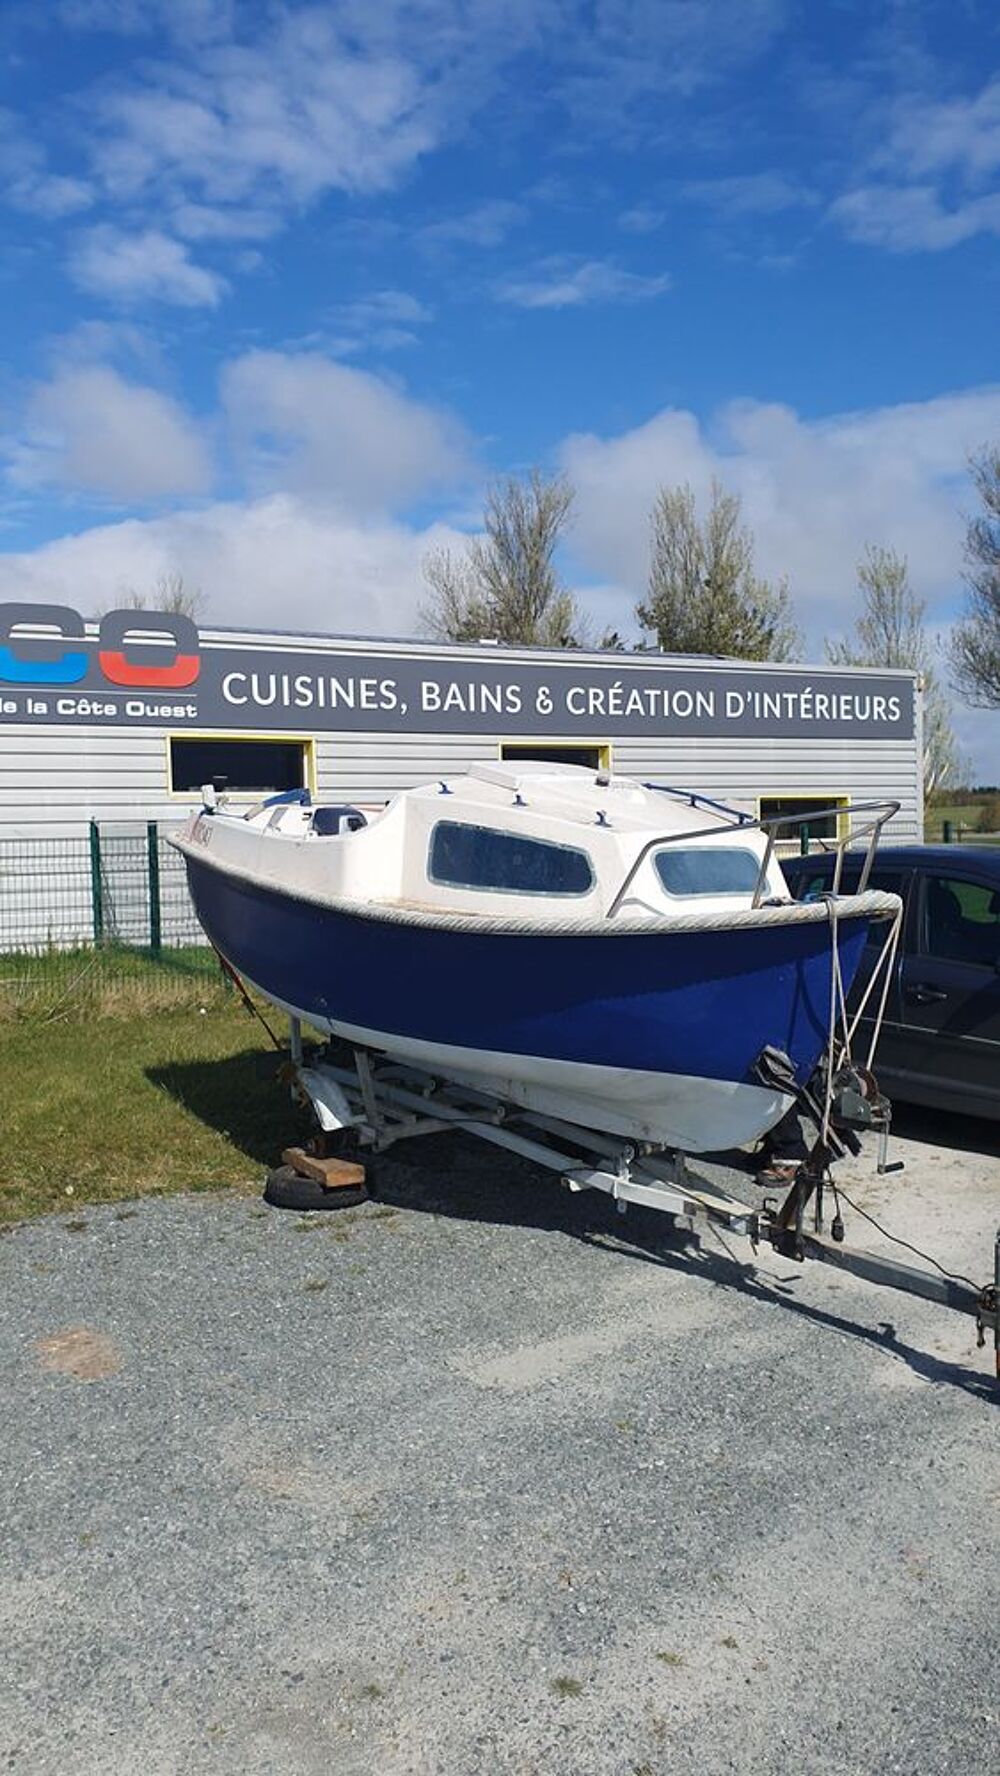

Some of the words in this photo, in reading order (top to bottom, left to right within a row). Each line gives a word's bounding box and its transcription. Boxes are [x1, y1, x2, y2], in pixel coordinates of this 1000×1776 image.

[26, 697, 48, 715] la
[56, 698, 118, 716] Côte
[125, 700, 198, 719] Ouest
[221, 672, 408, 716] CUISINES,
[421, 681, 522, 714] BAINS
[535, 686, 554, 715] &
[566, 680, 715, 718] CRÉATION
[725, 687, 902, 722] D'INTÉRIEURS
